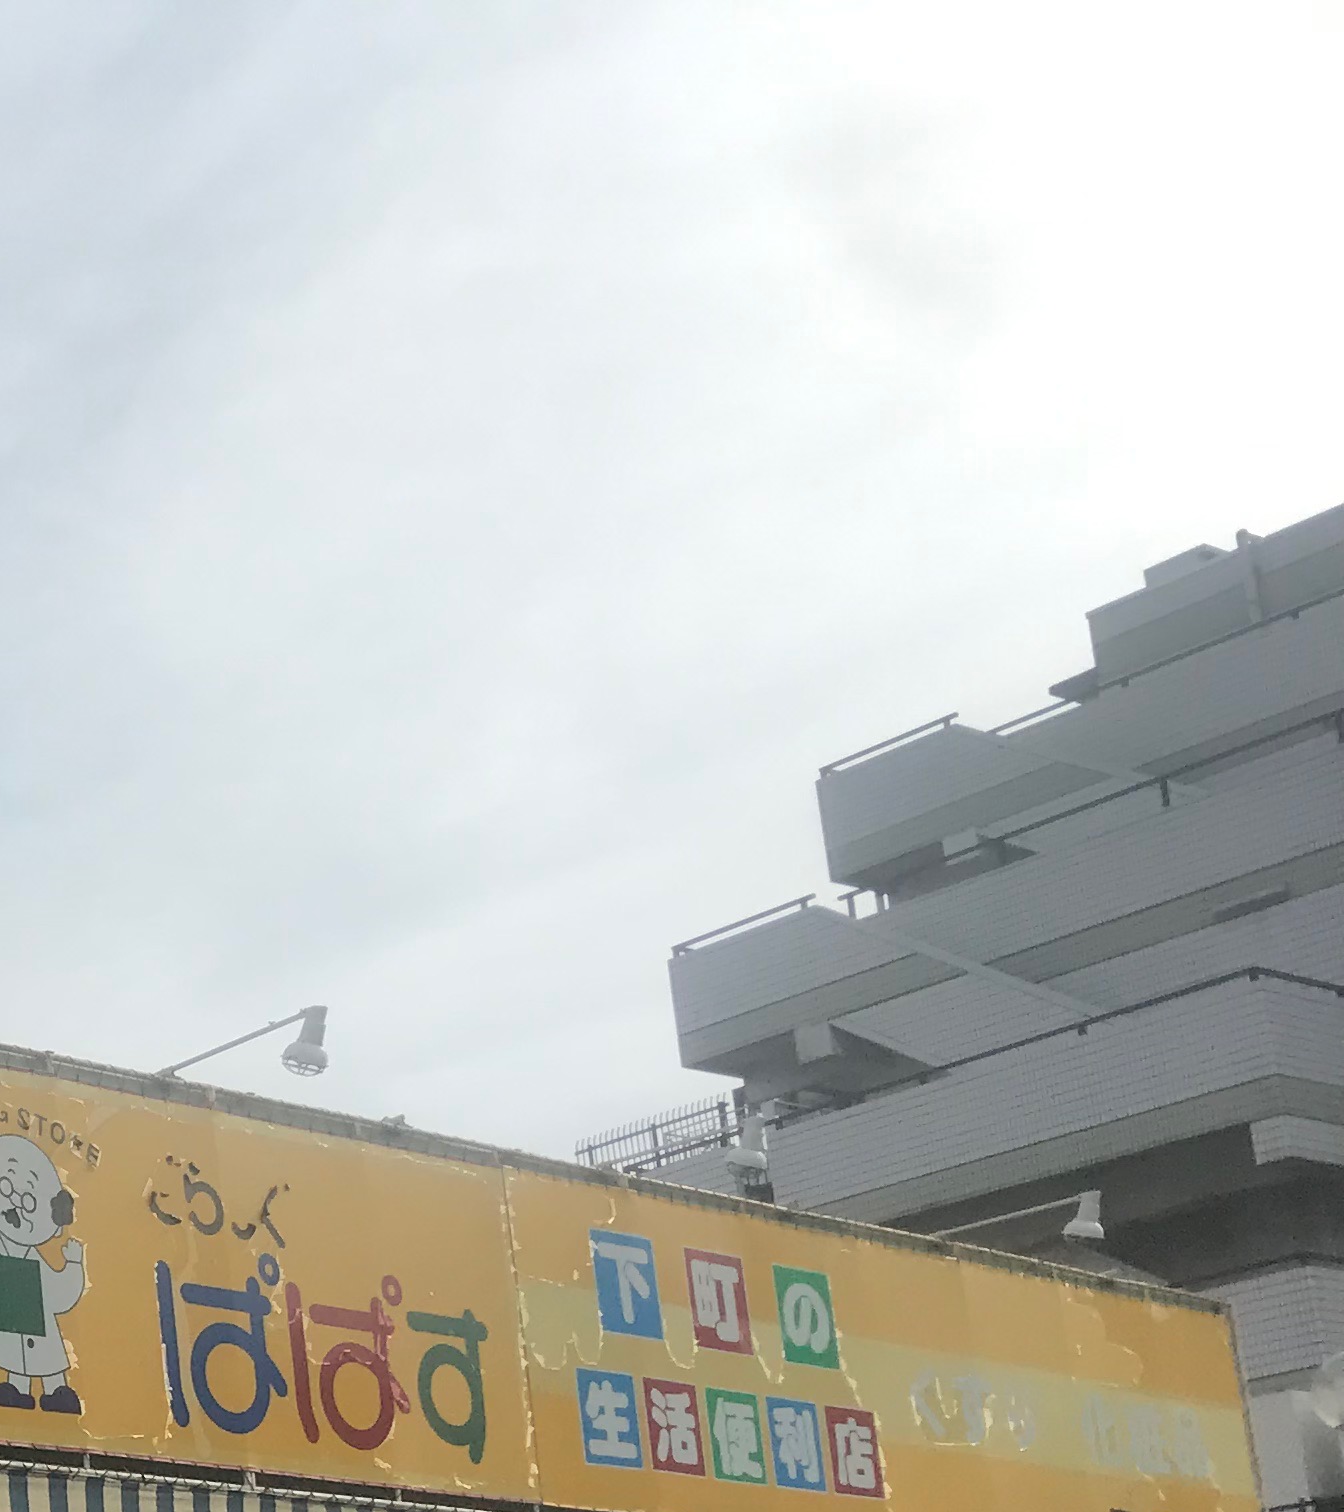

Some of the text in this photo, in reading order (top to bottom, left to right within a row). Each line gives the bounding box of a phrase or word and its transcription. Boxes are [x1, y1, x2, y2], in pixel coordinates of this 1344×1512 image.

[155, 1252, 489, 1464] ぱぱす
[590, 1236, 838, 1362] 下町の
[581, 1376, 883, 1494] 生活便利店
